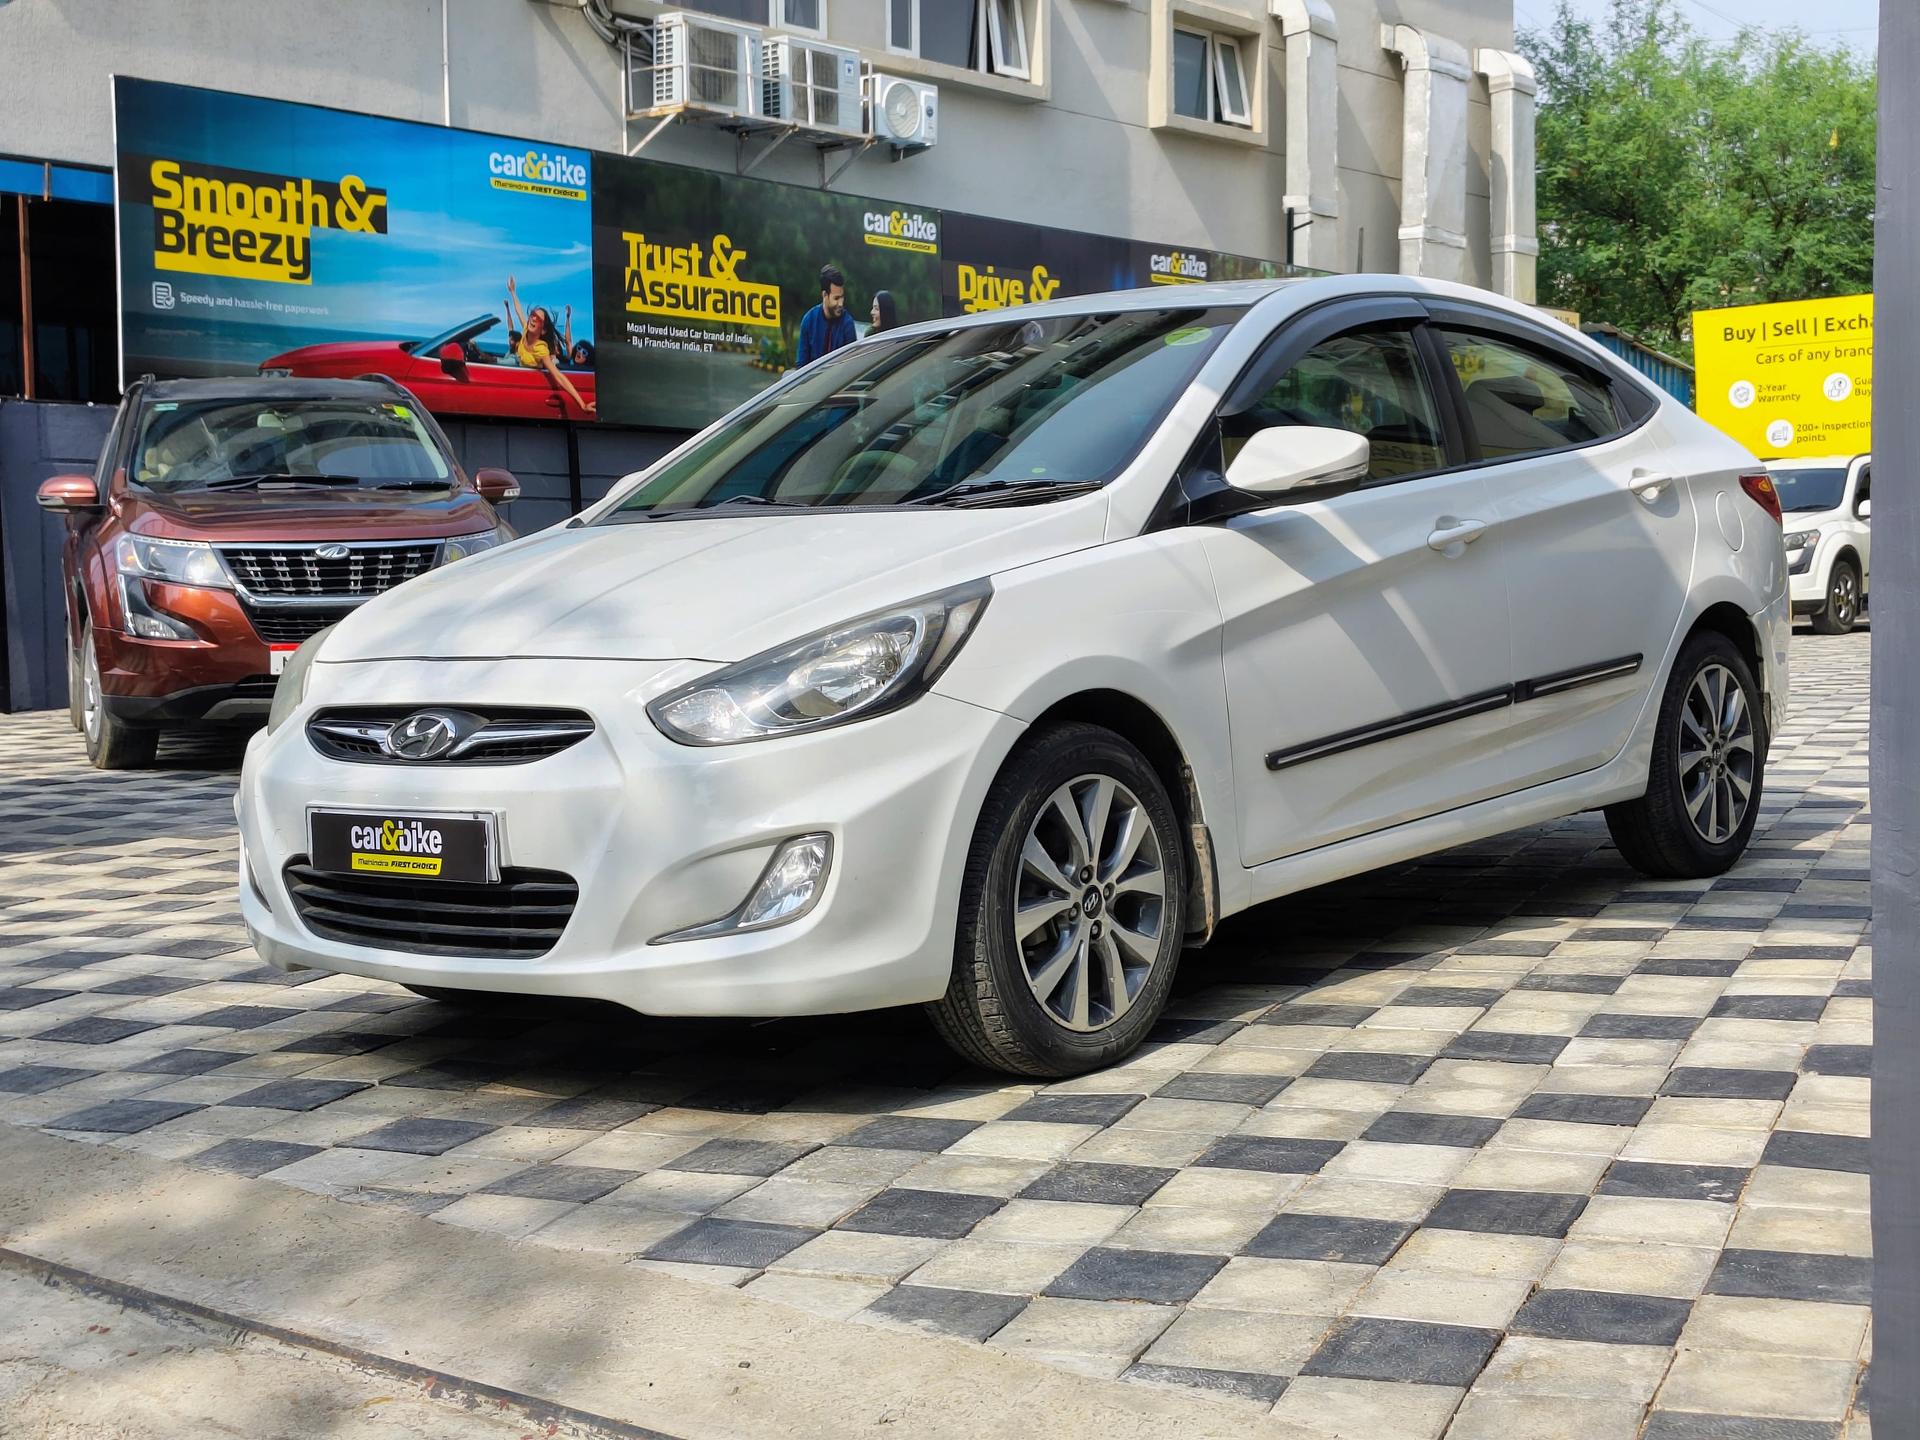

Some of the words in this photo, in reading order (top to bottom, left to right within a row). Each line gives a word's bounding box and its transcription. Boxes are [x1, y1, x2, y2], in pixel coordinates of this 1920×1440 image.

[489, 151, 586, 186] car&bike
[150, 160, 328, 228] Smooth
[335, 174, 387, 234] &
[864, 210, 937, 241] car&bike
[154, 208, 311, 280] Breezy
[622, 231, 703, 278] Trust
[709, 234, 747, 281] &
[1150, 251, 1207, 278] car&bike
[626, 270, 777, 320] Assurance
[958, 264, 1024, 308] Drive
[1029, 265, 1060, 304] &
[180, 291, 215, 307] Speedy
[216, 296, 233, 307] and
[234, 298, 283, 312] hassle-free
[626, 322, 646, 334] Most
[648, 323, 668, 335] loved
[669, 326, 688, 338] Used
[690, 328, 702, 339] Car
[703, 330, 725, 341] brand
[726, 333, 734, 342] of
[735, 333, 753, 344] India
[1723, 327, 1756, 343] Buy
[1773, 318, 1807, 337] Sell
[632, 336, 643, 348] By
[644, 337, 680, 350] Franchise
[682, 341, 703, 353] India,
[704, 343, 714, 353] ET
[1756, 353, 1785, 365] Cars
[1789, 349, 1803, 362] of
[1807, 350, 1831, 362] any
[1757, 393, 1801, 404] Warranty
[1758, 383, 1787, 393] 2-Year
[1796, 433, 1827, 444] points
[1797, 423, 1819, 433] 200+
[351, 820, 443, 855] car&bike
